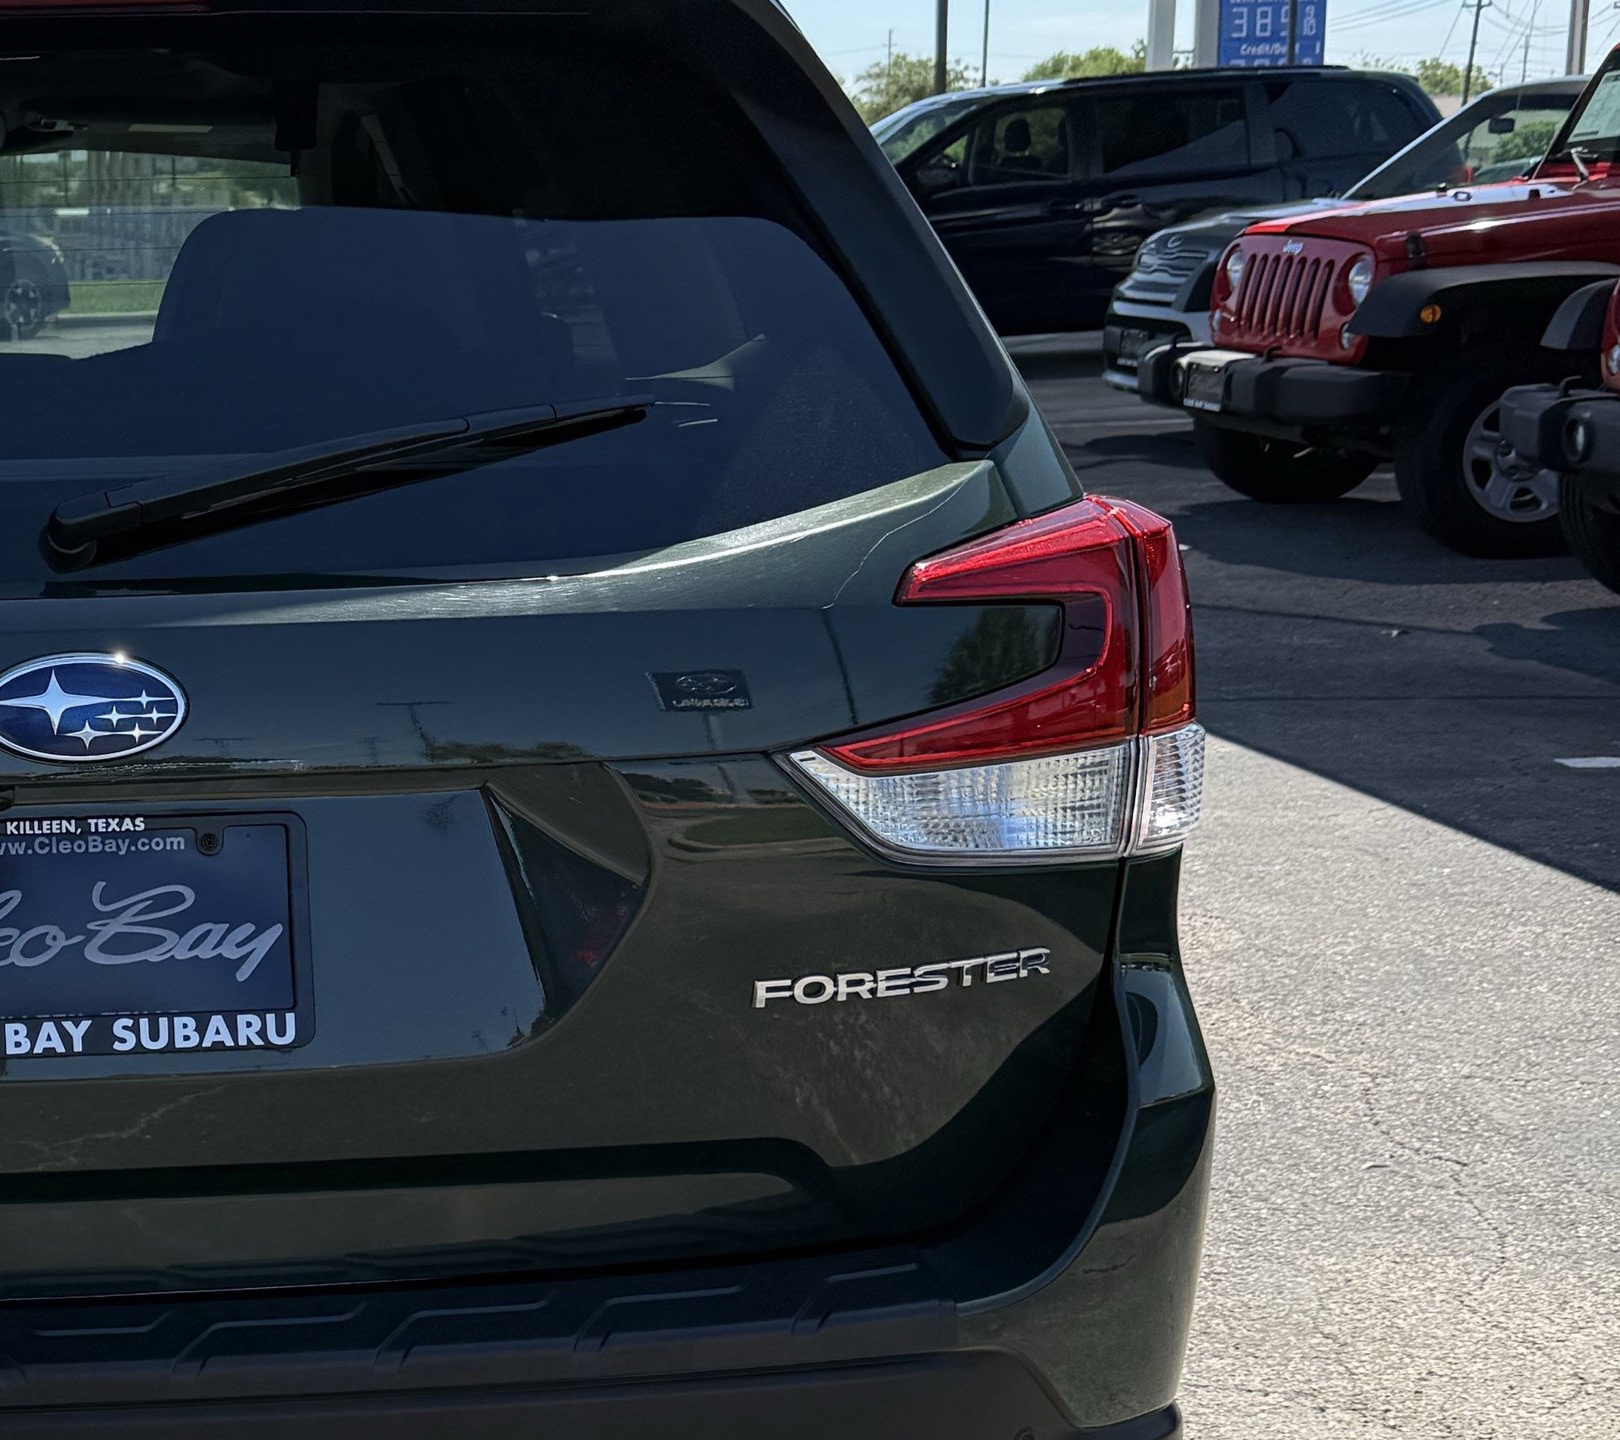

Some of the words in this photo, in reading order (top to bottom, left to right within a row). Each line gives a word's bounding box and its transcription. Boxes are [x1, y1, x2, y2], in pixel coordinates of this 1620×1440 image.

[6, 819, 82, 836] KILLEEN,
[88, 817, 146, 832] TEXAS
[83, 881, 284, 982] Bay
[751, 946, 1052, 1009] FORESTER
[5, 1019, 92, 1055] BAY
[112, 1012, 296, 1052] SUBARU
